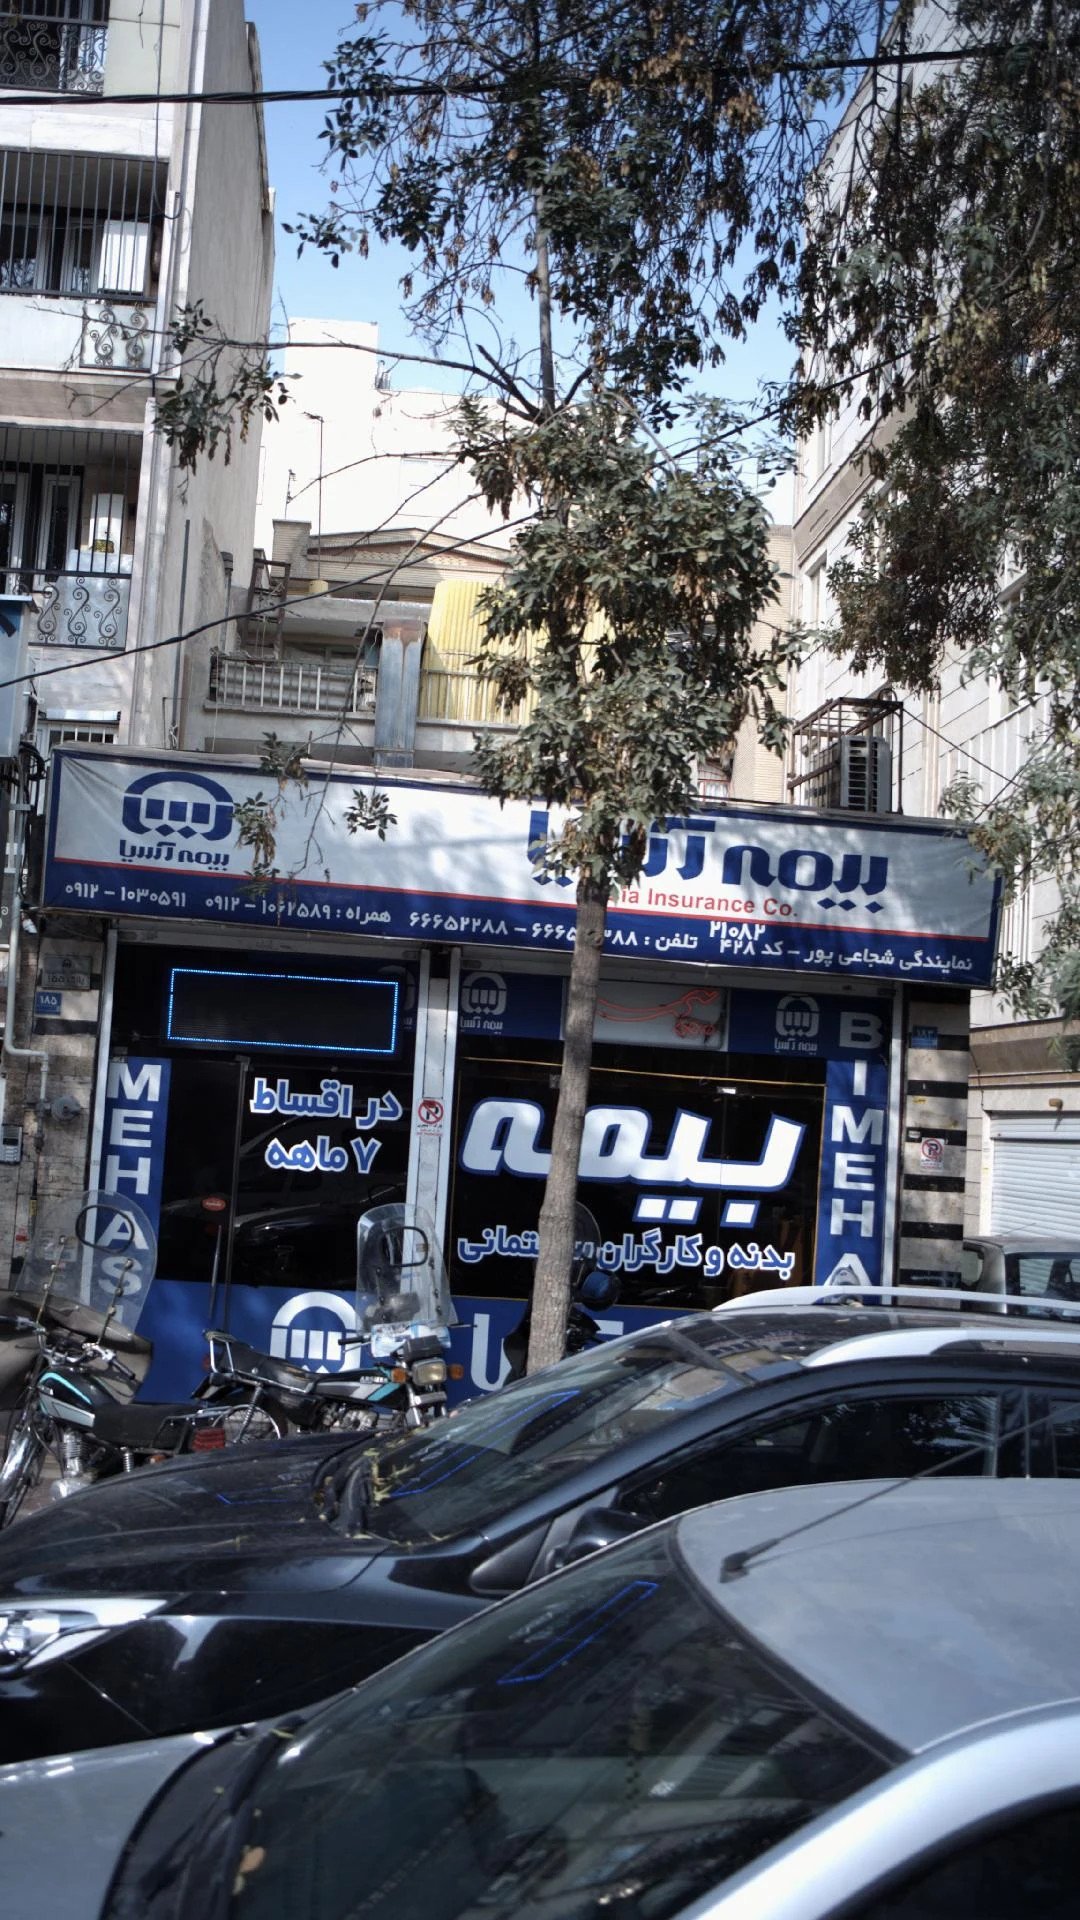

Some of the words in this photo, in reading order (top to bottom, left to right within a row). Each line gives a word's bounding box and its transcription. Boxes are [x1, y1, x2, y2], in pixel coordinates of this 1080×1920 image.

[119, 839, 177, 863] آسیا
[178, 849, 230, 871] بیمه
[722, 844, 889, 913] بیمه
[648, 887, 762, 914] Insurance
[763, 898, 798, 917] Co.
[409, 911, 509, 935] ۶۶۶۵۲۲۸۸
[531, 921, 638, 946] ۶۶۶۵۸۸
[709, 920, 766, 941] ۲۱۰۸۲
[719, 939, 756, 956] ۴۲۸
[761, 940, 784, 956] کد
[804, 948, 833, 967] پور
[838, 949, 895, 968] شجاعی
[899, 951, 973, 974] نمایندگی
[250, 1077, 353, 1119] اقساط
[355, 1090, 403, 1130] در
[265, 1135, 349, 1172] ماهه
[350, 1136, 382, 1174] ۷
[460, 1097, 806, 1228] بیمه
[458, 1225, 595, 1263] ستمانی
[596, 1228, 703, 1275] کارگران
[702, 1245, 723, 1277] و
[726, 1242, 796, 1281] بدنه
